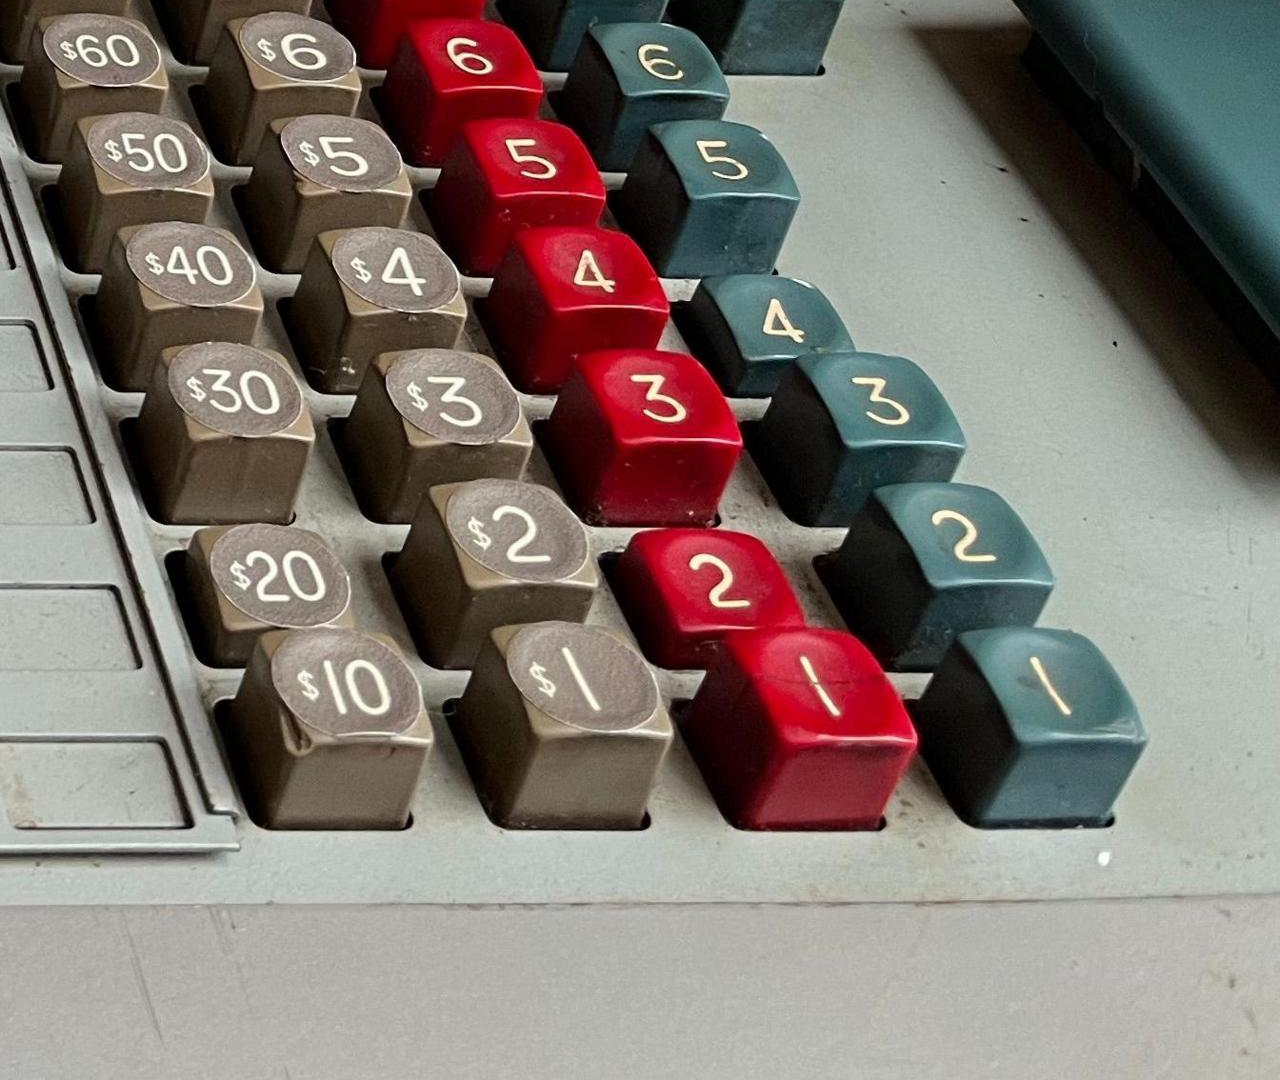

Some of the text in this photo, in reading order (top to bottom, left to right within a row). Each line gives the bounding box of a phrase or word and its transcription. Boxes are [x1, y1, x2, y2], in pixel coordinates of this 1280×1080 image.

[59, 34, 140, 68] $60
[256, 33, 327, 73] $6
[446, 37, 494, 75] 6
[638, 43, 684, 80] 6
[104, 132, 189, 174] $50
[298, 136, 369, 177] $5
[505, 138, 557, 179] 5
[696, 140, 749, 180] 5
[144, 245, 234, 286] $40
[350, 247, 427, 296] $4
[573, 249, 616, 293] 4
[762, 298, 805, 344] 4
[186, 368, 281, 415] $30
[406, 376, 483, 427] $3
[630, 374, 687, 423] 3
[851, 376, 910, 426] 3
[467, 504, 552, 563] $2
[931, 509, 997, 562] 2
[225, 550, 326, 602] $20
[689, 553, 751, 608] 2
[296, 659, 391, 716] $10
[528, 646, 601, 712] $1
[799, 655, 841, 717] 1
[1029, 656, 1072, 716] 1
